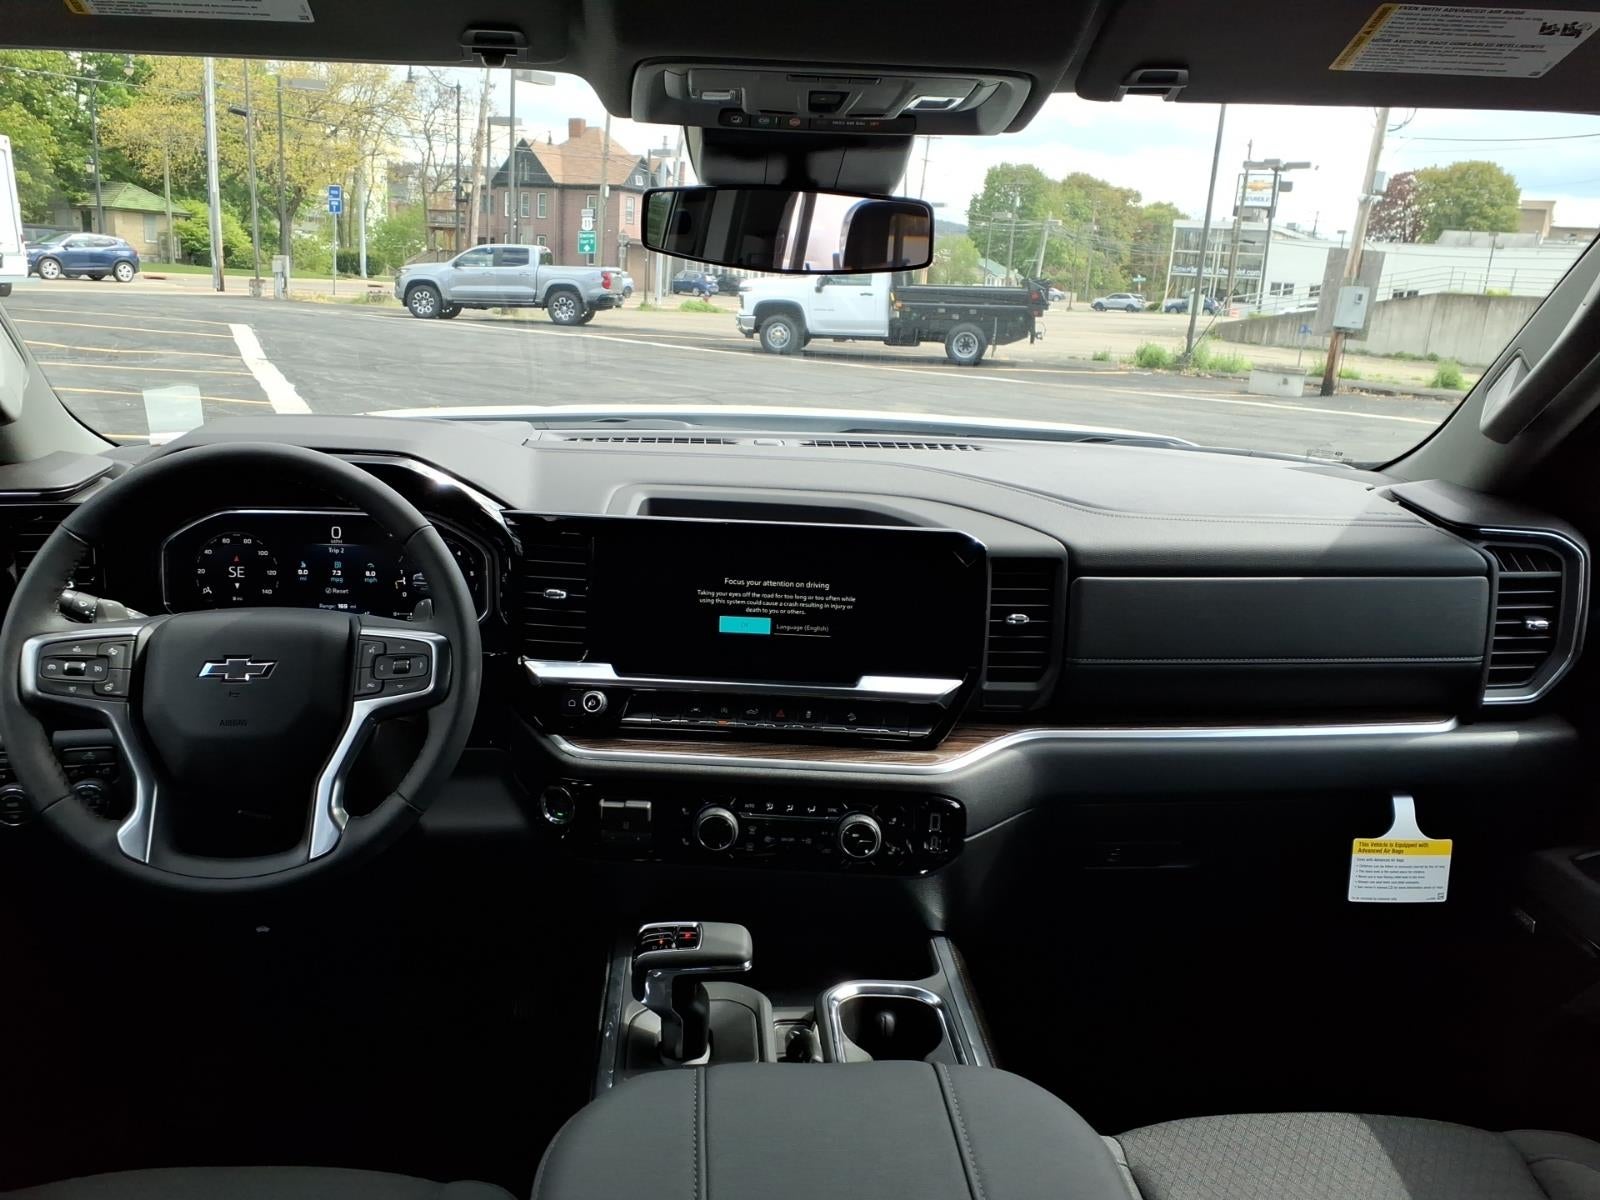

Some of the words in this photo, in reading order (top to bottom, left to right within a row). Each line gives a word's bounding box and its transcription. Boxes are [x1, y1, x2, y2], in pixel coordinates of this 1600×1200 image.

[228, 566, 246, 578] SE
[725, 577, 745, 586] Focus
[746, 579, 761, 588] your
[762, 578, 794, 588] attention
[805, 580, 830, 591] driving
[697, 589, 715, 598] Taking
[715, 591, 728, 599] your
[794, 593, 807, 602] long
[825, 594, 840, 602] often
[699, 597, 715, 606] using
[726, 599, 746, 607] system
[799, 601, 823, 610] resulting
[829, 603, 846, 611] injury
[775, 623, 803, 632] Language
[803, 624, 829, 633] (English)
